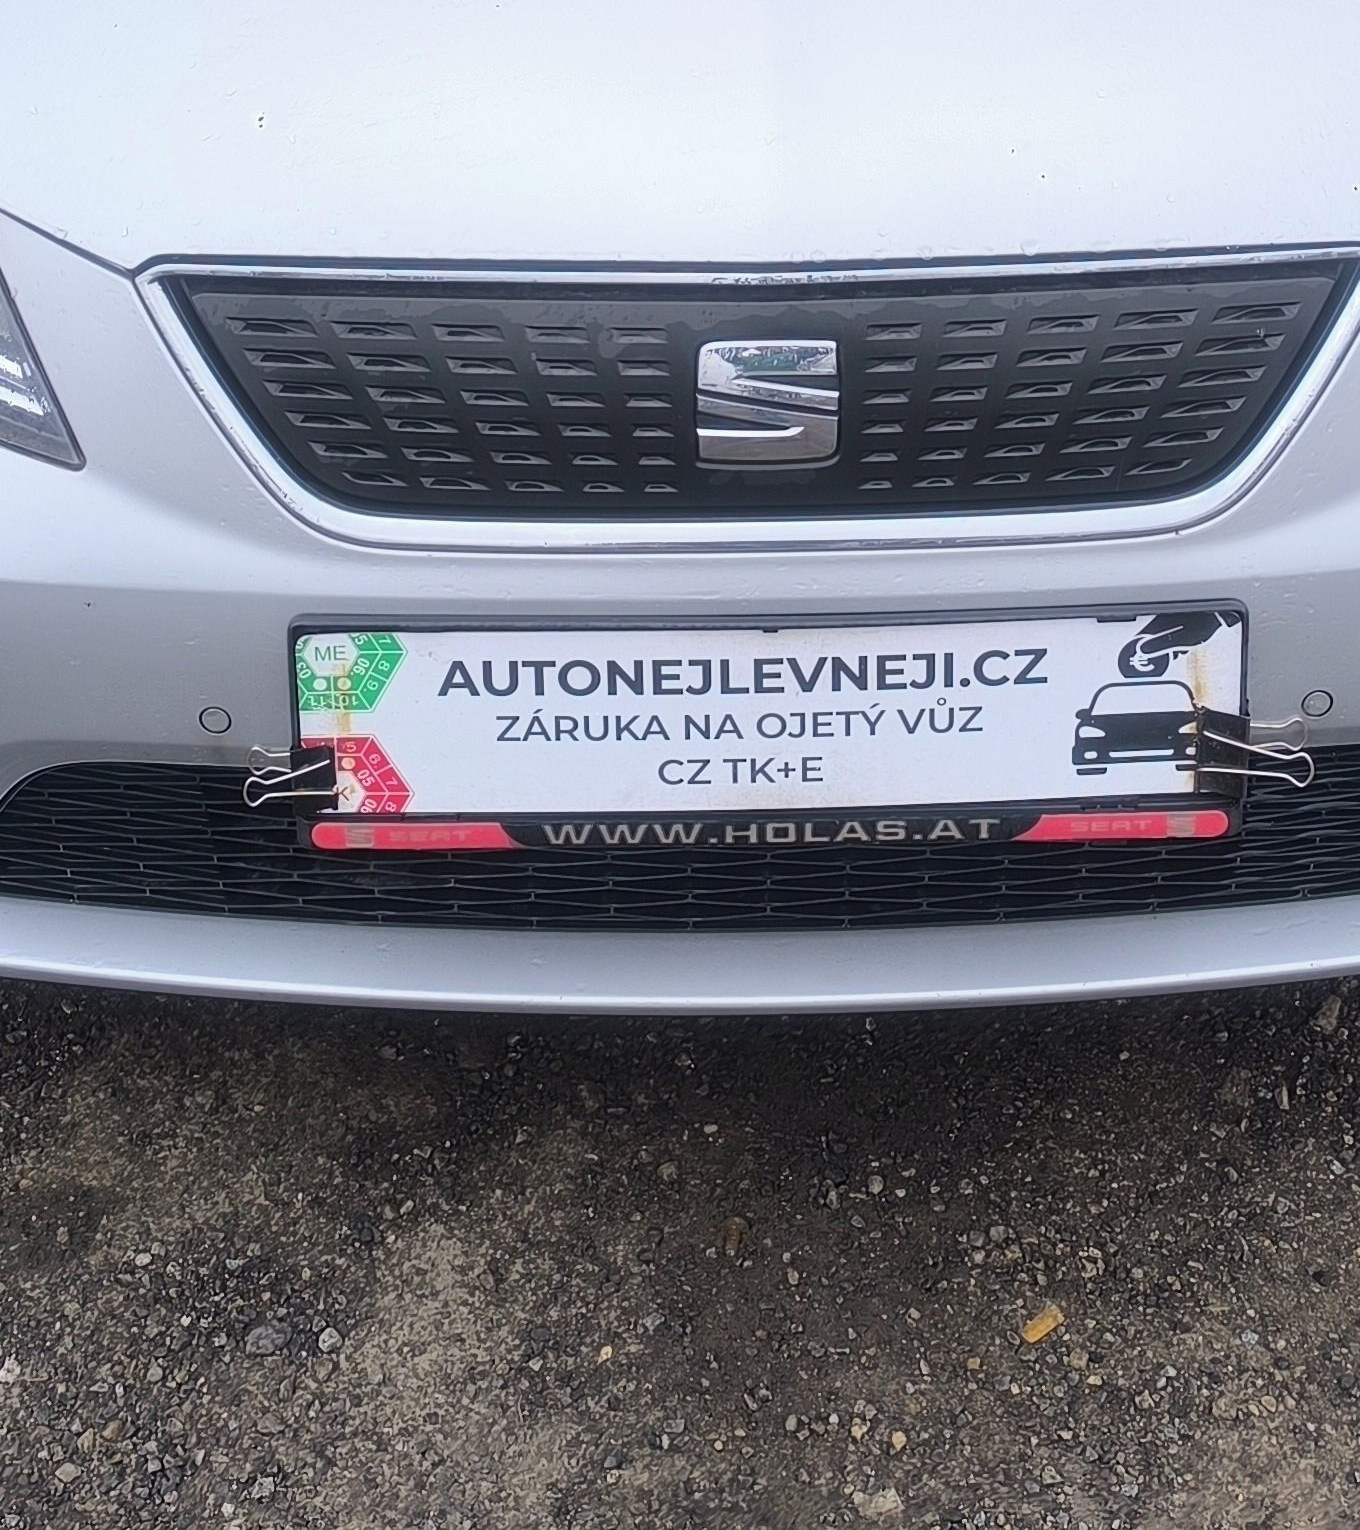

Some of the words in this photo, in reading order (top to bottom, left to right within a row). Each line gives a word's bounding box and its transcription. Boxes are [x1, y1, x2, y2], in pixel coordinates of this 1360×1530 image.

[314, 645, 349, 662] ME
[378, 660, 390, 671] 8
[437, 648, 1048, 697] AUTONEJLEVNEJI.CZ
[496, 708, 671, 742] ZÁRUKA
[684, 713, 744, 740] NA
[756, 702, 886, 739] OJETÝ
[896, 697, 983, 735] VŮZ
[658, 759, 712, 785] CZ
[722, 756, 824, 785] TK+E
[387, 829, 472, 843] SEAT
[543, 818, 1001, 845] WWW.HOLAS.AT
[1069, 819, 1153, 833] SEAT
